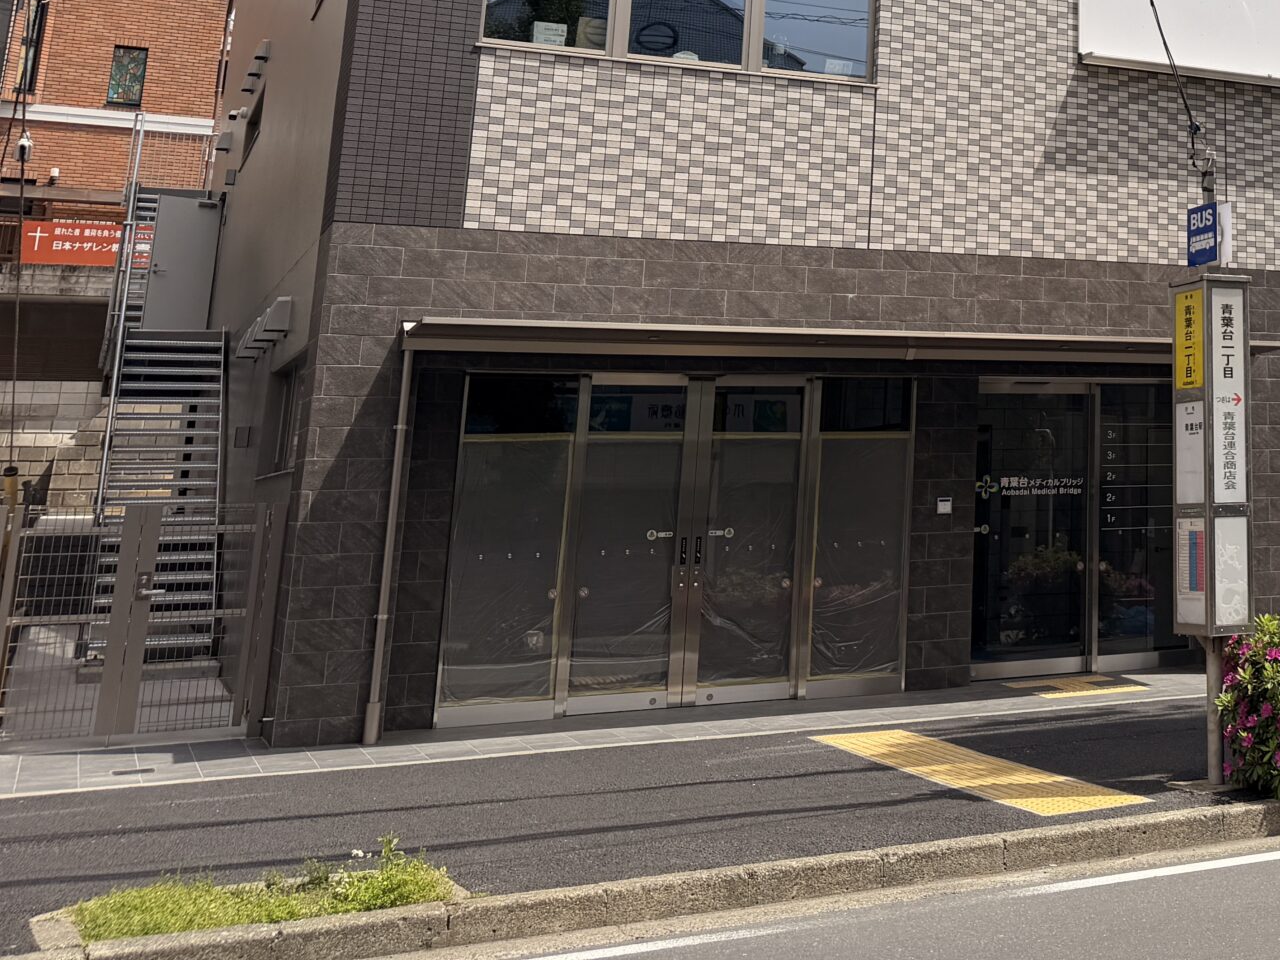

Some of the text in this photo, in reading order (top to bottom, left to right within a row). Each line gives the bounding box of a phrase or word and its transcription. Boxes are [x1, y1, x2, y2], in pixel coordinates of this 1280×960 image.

[1190, 208, 1214, 230] BUS
[1184, 304, 1193, 378] 青葉台一丁目
[1221, 303, 1235, 379] 青葉台一丁目
[1107, 430, 1117, 439] 3F
[1222, 411, 1237, 490] 青葉台連合商店会
[1107, 451, 1117, 460] 3F
[1106, 472, 1117, 481] 2F
[1001, 488, 1030, 496] Aobadai
[1059, 487, 1082, 495] Bridge
[1106, 493, 1117, 502] 2F
[1106, 514, 1117, 523] 1F
